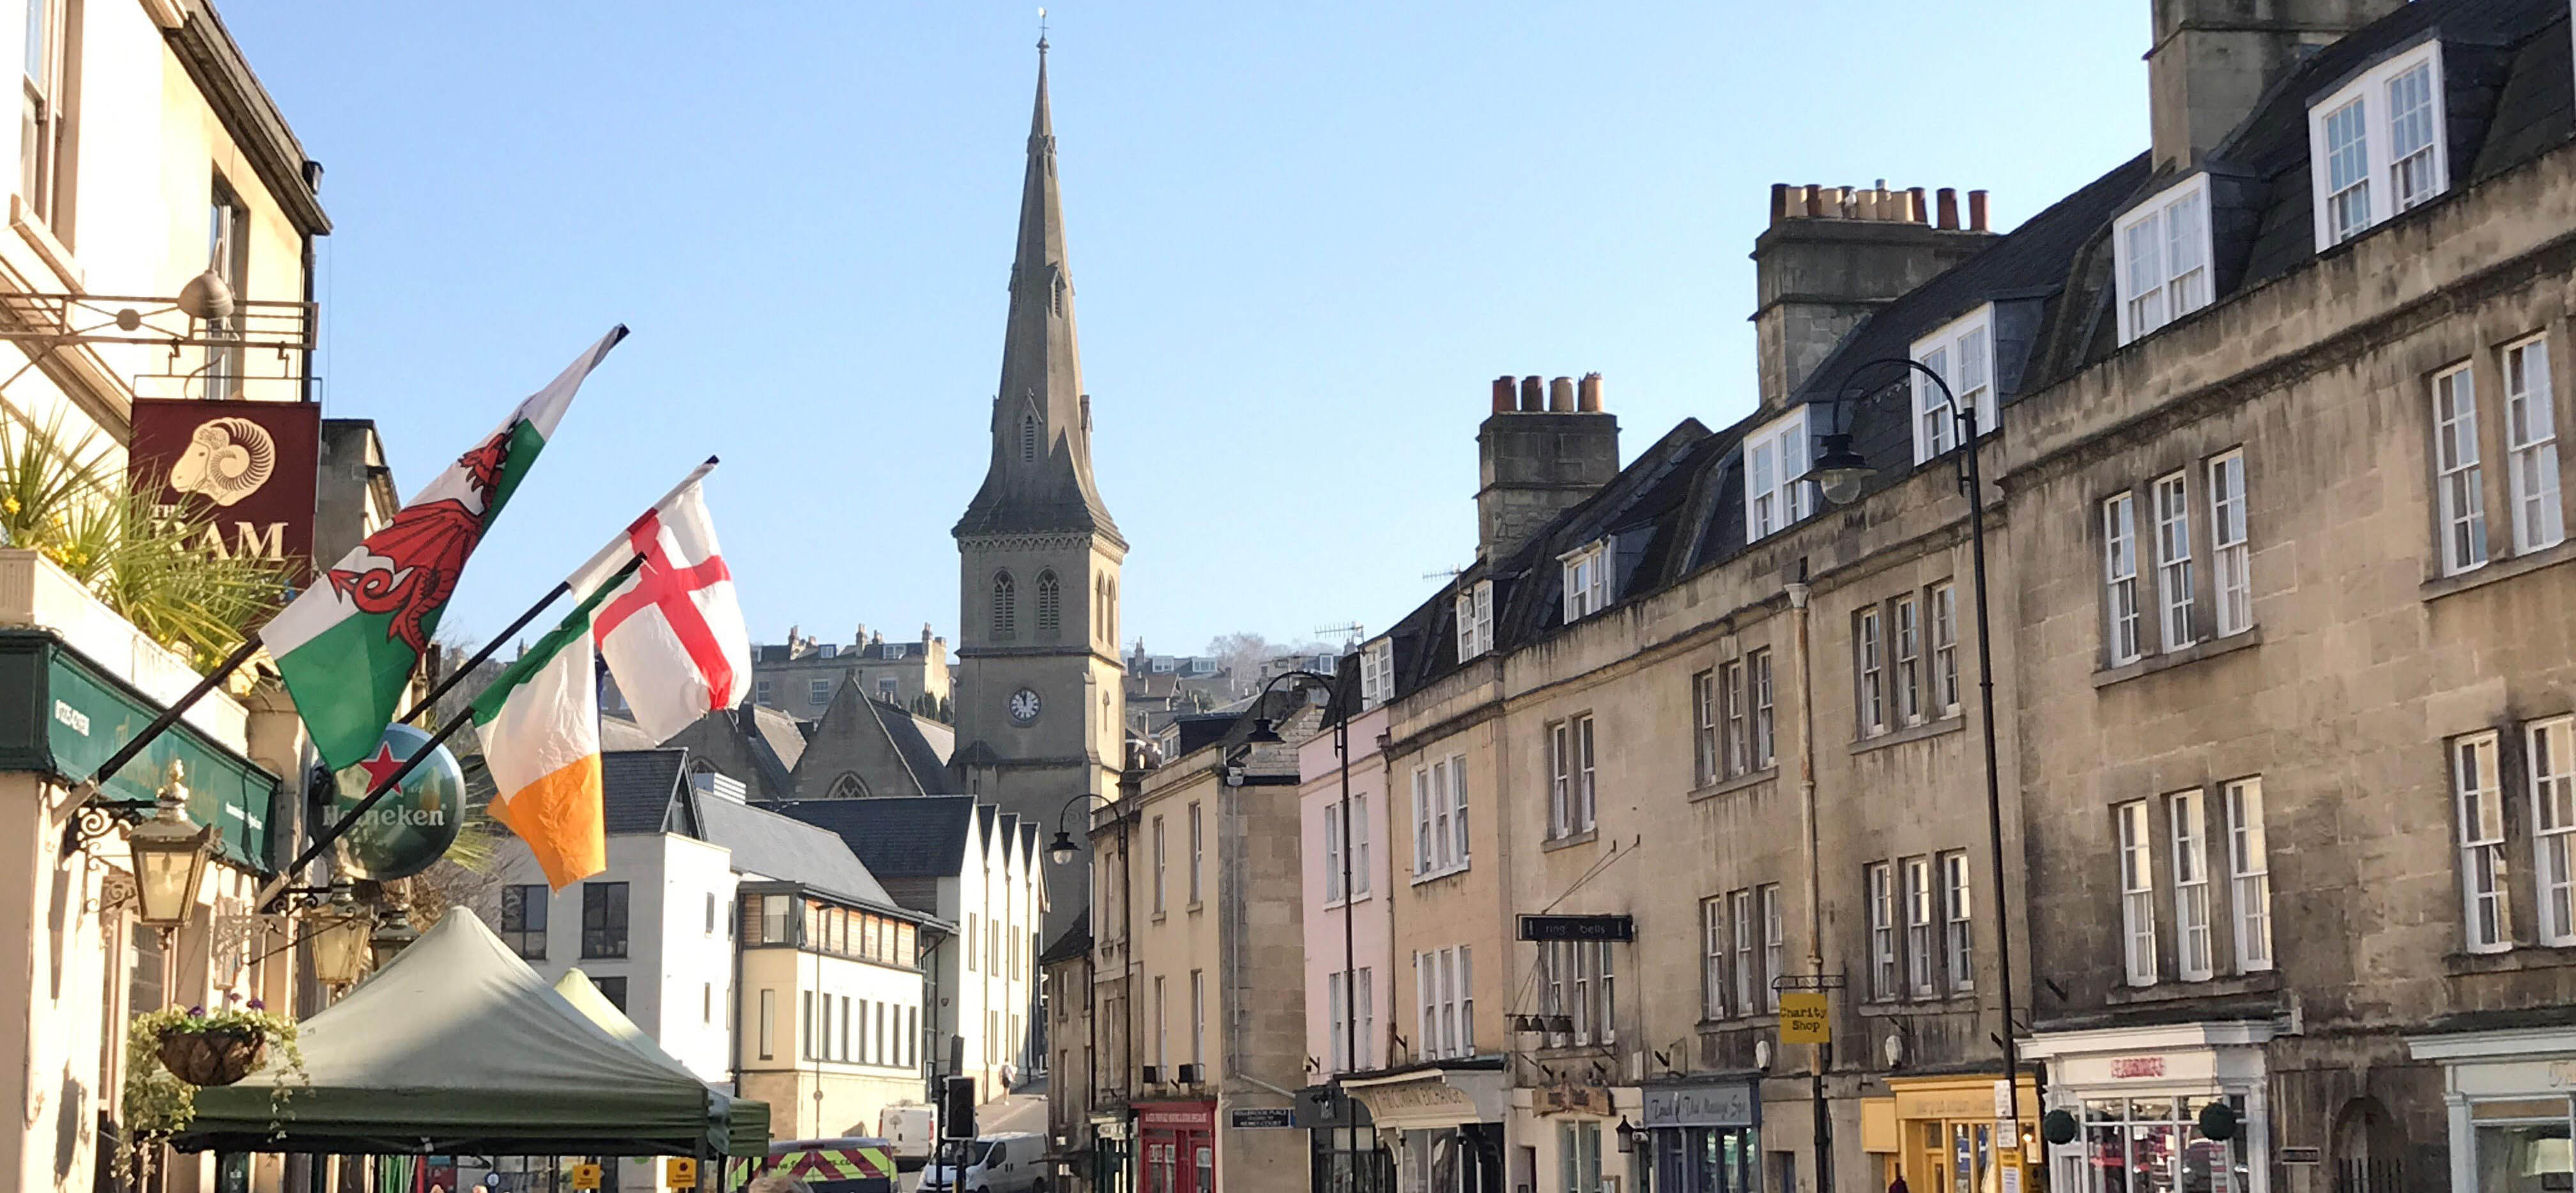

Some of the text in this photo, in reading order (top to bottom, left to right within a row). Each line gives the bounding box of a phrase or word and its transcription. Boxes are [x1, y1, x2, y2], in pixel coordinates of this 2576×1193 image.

[151, 519, 289, 561] RAM
[322, 804, 445, 826] Hneken
[1545, 924, 1606, 936] ring bells
[1780, 1007, 1826, 1019] Charity
[1792, 1020, 1820, 1033] Shop
